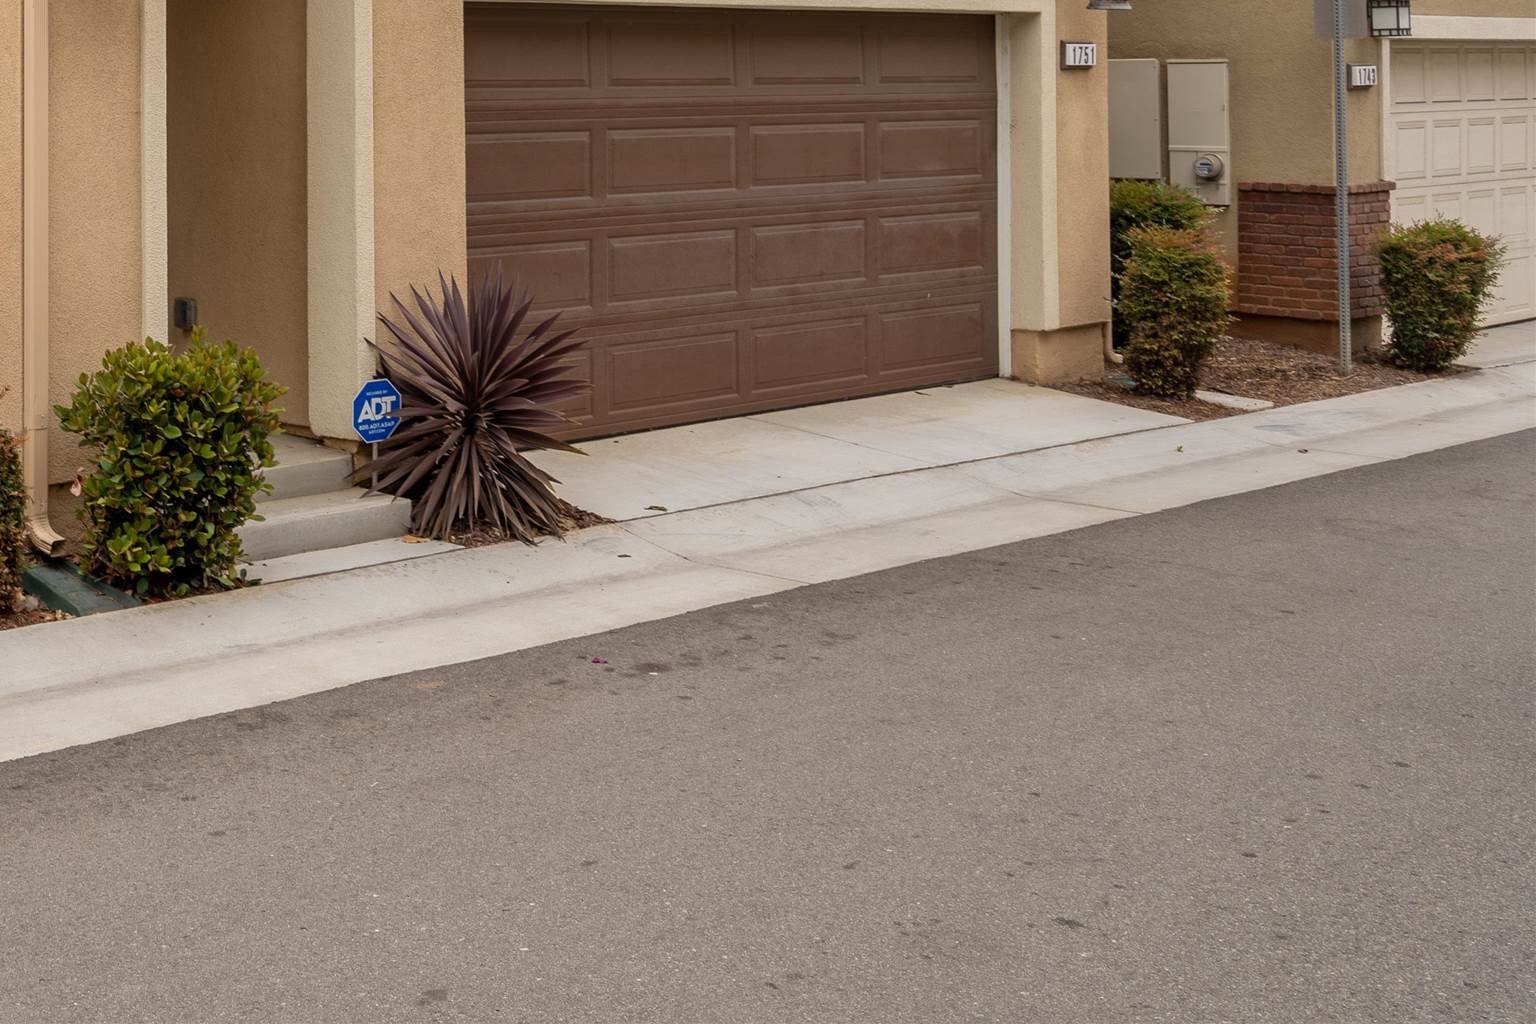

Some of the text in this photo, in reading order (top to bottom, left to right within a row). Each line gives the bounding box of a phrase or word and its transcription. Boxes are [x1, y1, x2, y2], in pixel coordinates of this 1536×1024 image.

[1072, 46, 1095, 64] 1751
[1358, 68, 1376, 84] 1743
[357, 395, 397, 424] ADT
